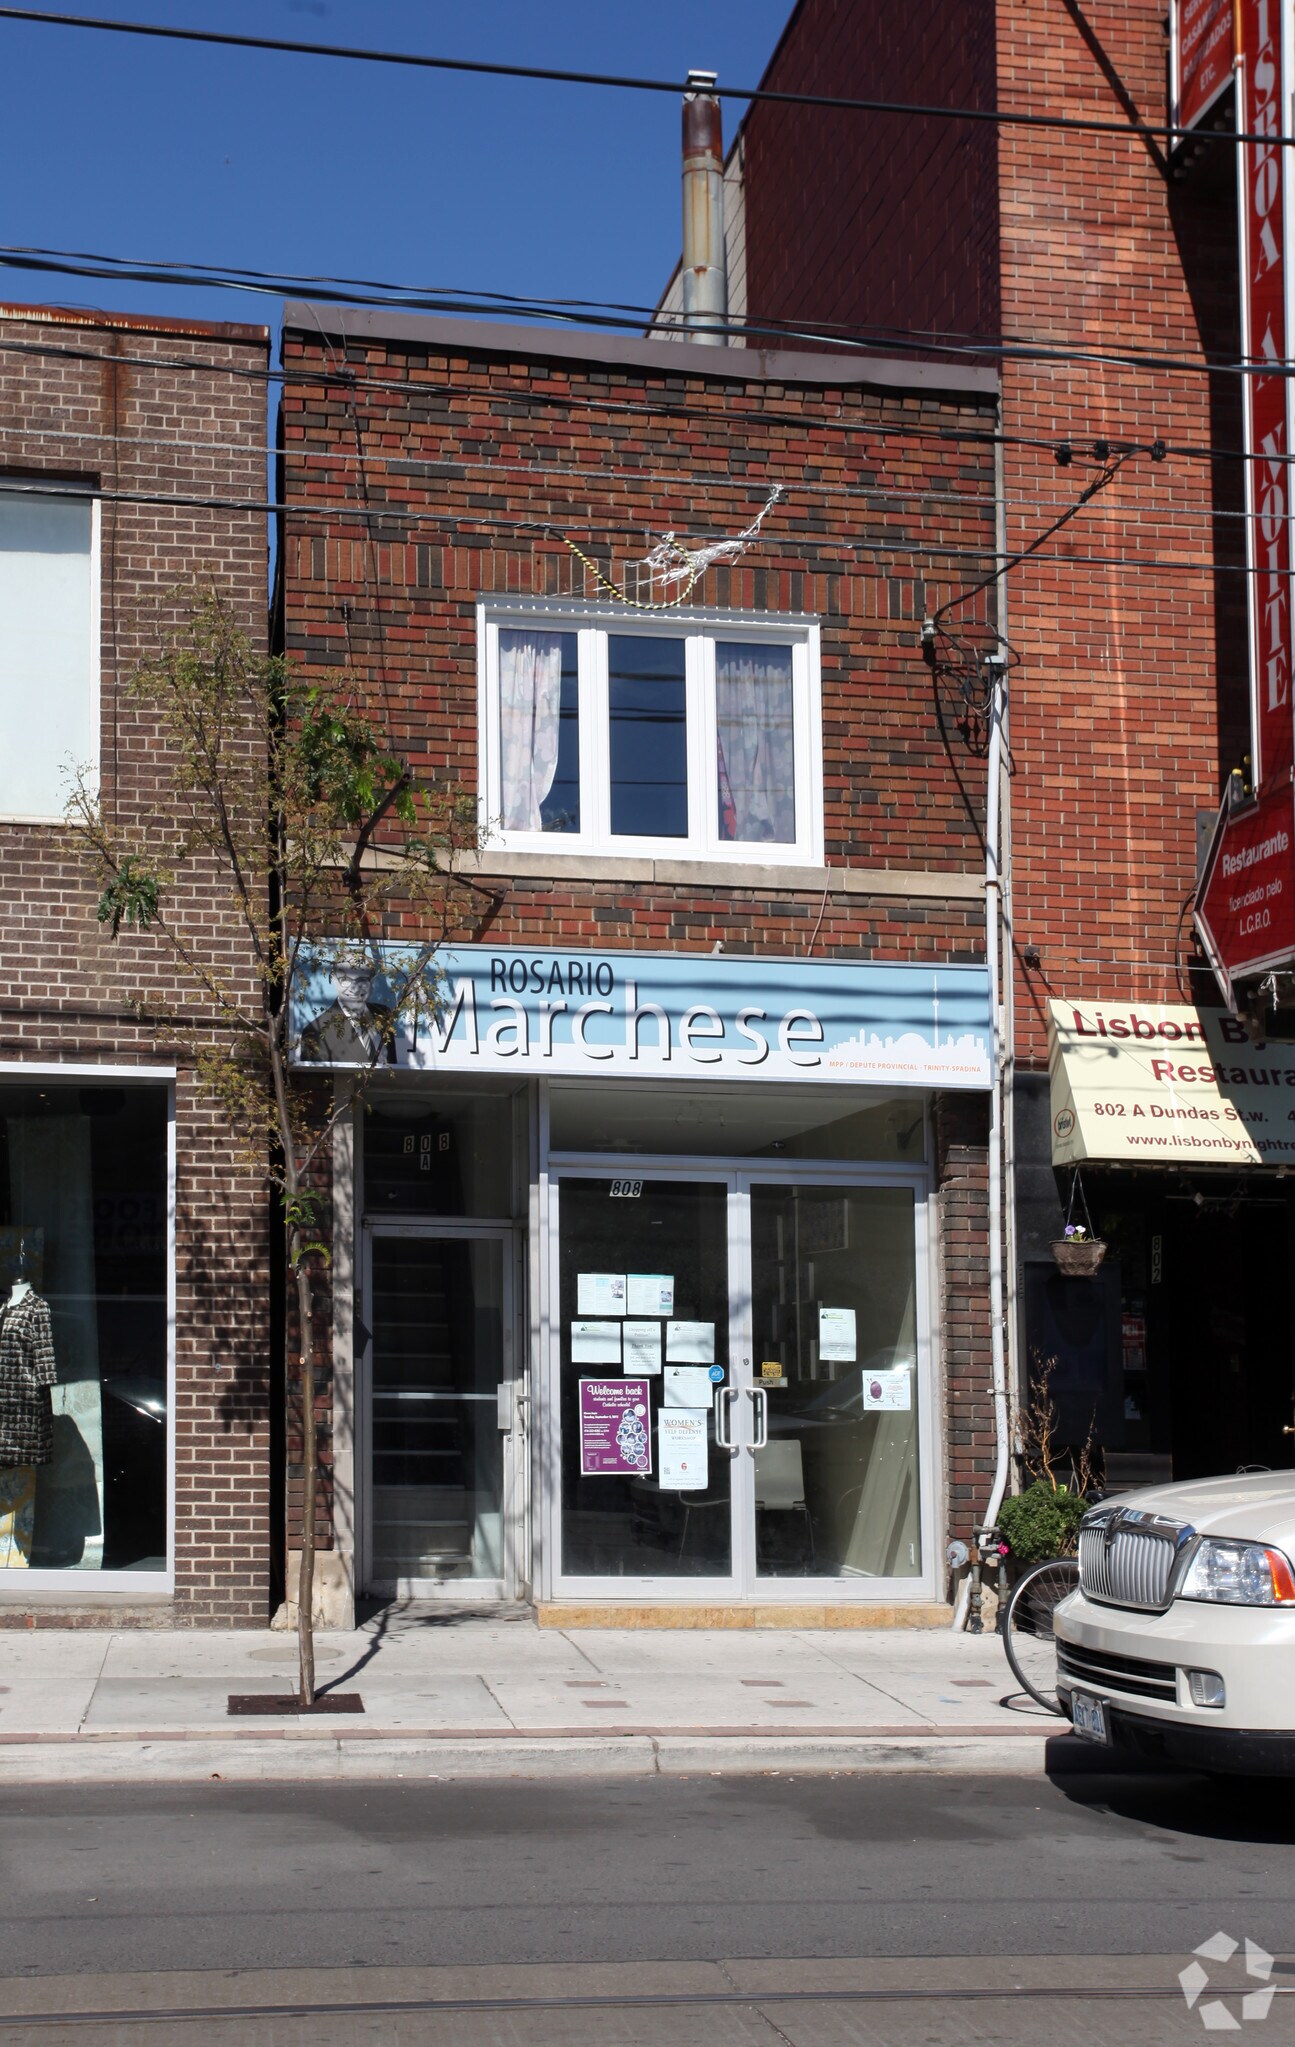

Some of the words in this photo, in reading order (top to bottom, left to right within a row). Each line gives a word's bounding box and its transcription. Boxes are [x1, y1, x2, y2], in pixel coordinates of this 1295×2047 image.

[1253, 0, 1280, 283] ISBOA
[1260, 421, 1288, 712] NOITE
[1223, 831, 1289, 878] Restaurante
[1229, 886, 1264, 912] licenciado
[1266, 878, 1282, 899] pelo
[1240, 909, 1271, 936] L.C.B.O.
[490, 958, 614, 996] ROSARIO
[407, 976, 825, 1067] Marchese
[1072, 1010, 1208, 1042] Lisbon
[878, 1063, 918, 1071] PROVINCIAL
[924, 1064, 982, 1073] TRINITY-SPADINA
[1094, 1102, 1127, 1116] 802
[1133, 1104, 1146, 1117] A
[1150, 1104, 1220, 1120] Dundas
[405, 1135, 449, 1152] 808
[611, 1180, 642, 1197] 808
[1153, 1237, 1161, 1282] 802
[587, 1384, 623, 1396] Welcome
[625, 1385, 643, 1396] back
